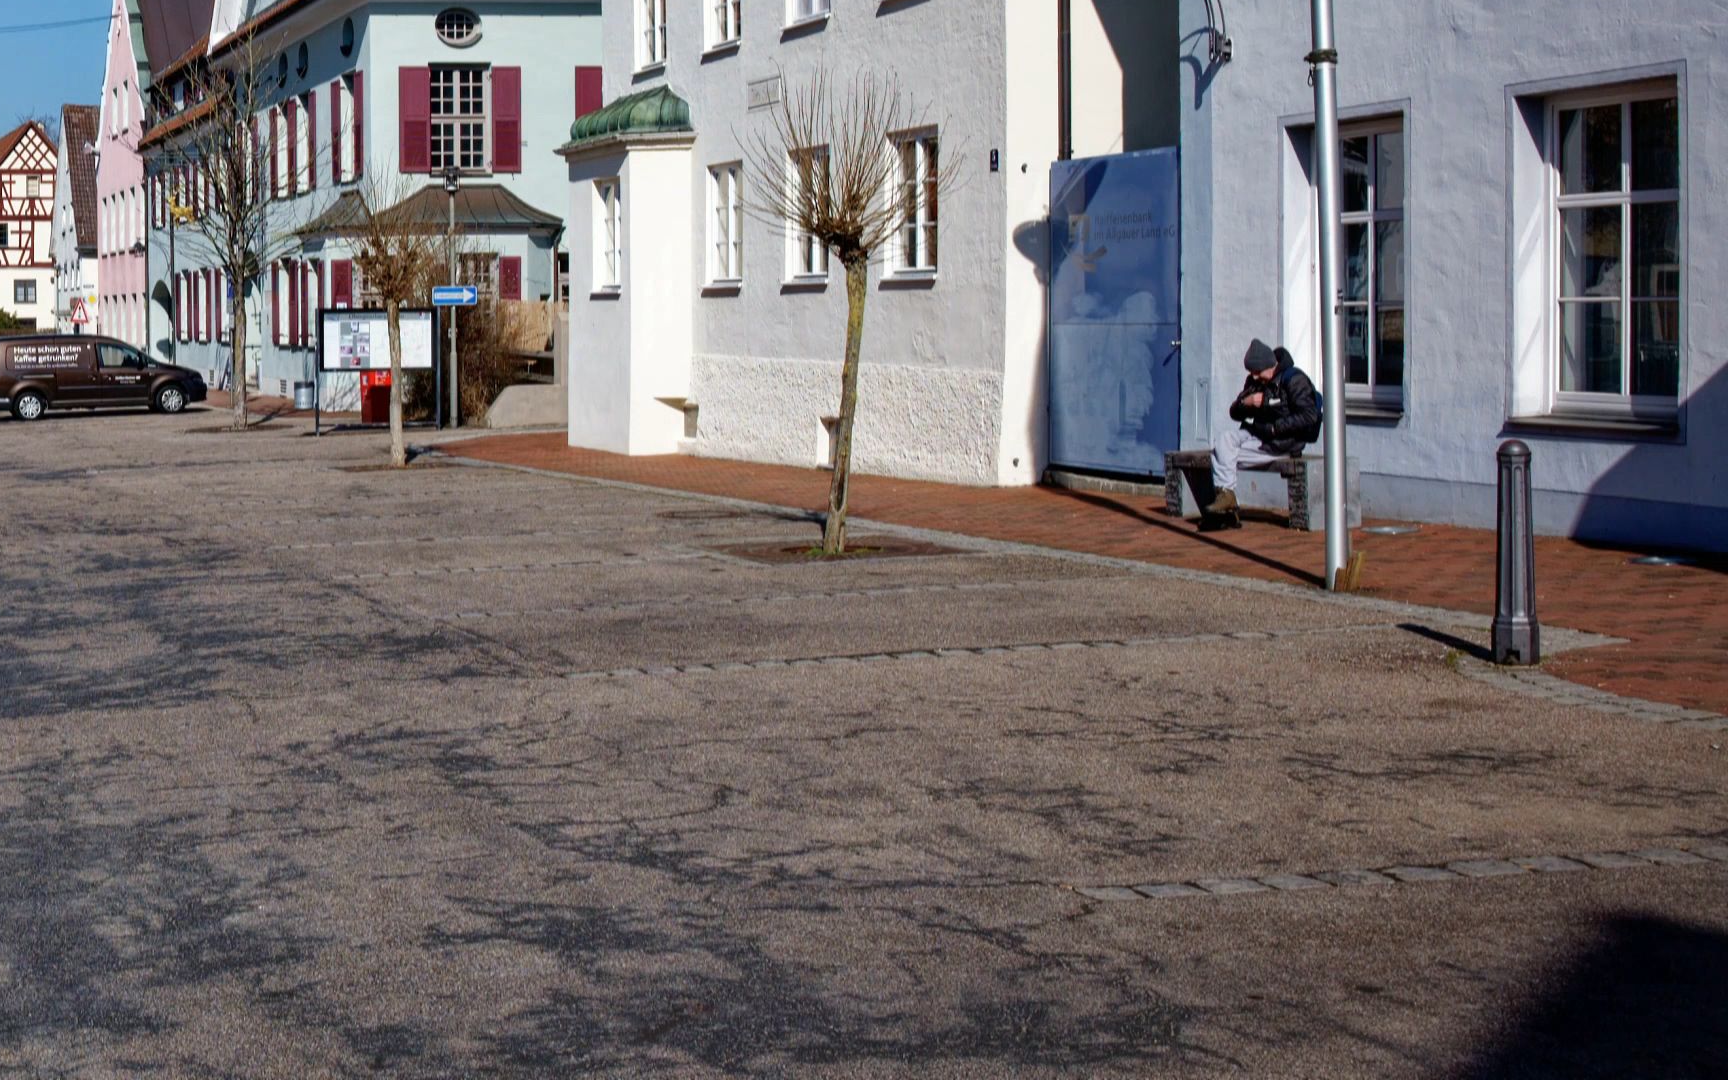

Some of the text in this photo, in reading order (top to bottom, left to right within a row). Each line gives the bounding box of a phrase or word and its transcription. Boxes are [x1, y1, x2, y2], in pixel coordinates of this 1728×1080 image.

[1141, 225, 1161, 239] Land
[13, 344, 82, 354] Heute schon guten
[14, 354, 79, 364] Kaffee getrunken?
